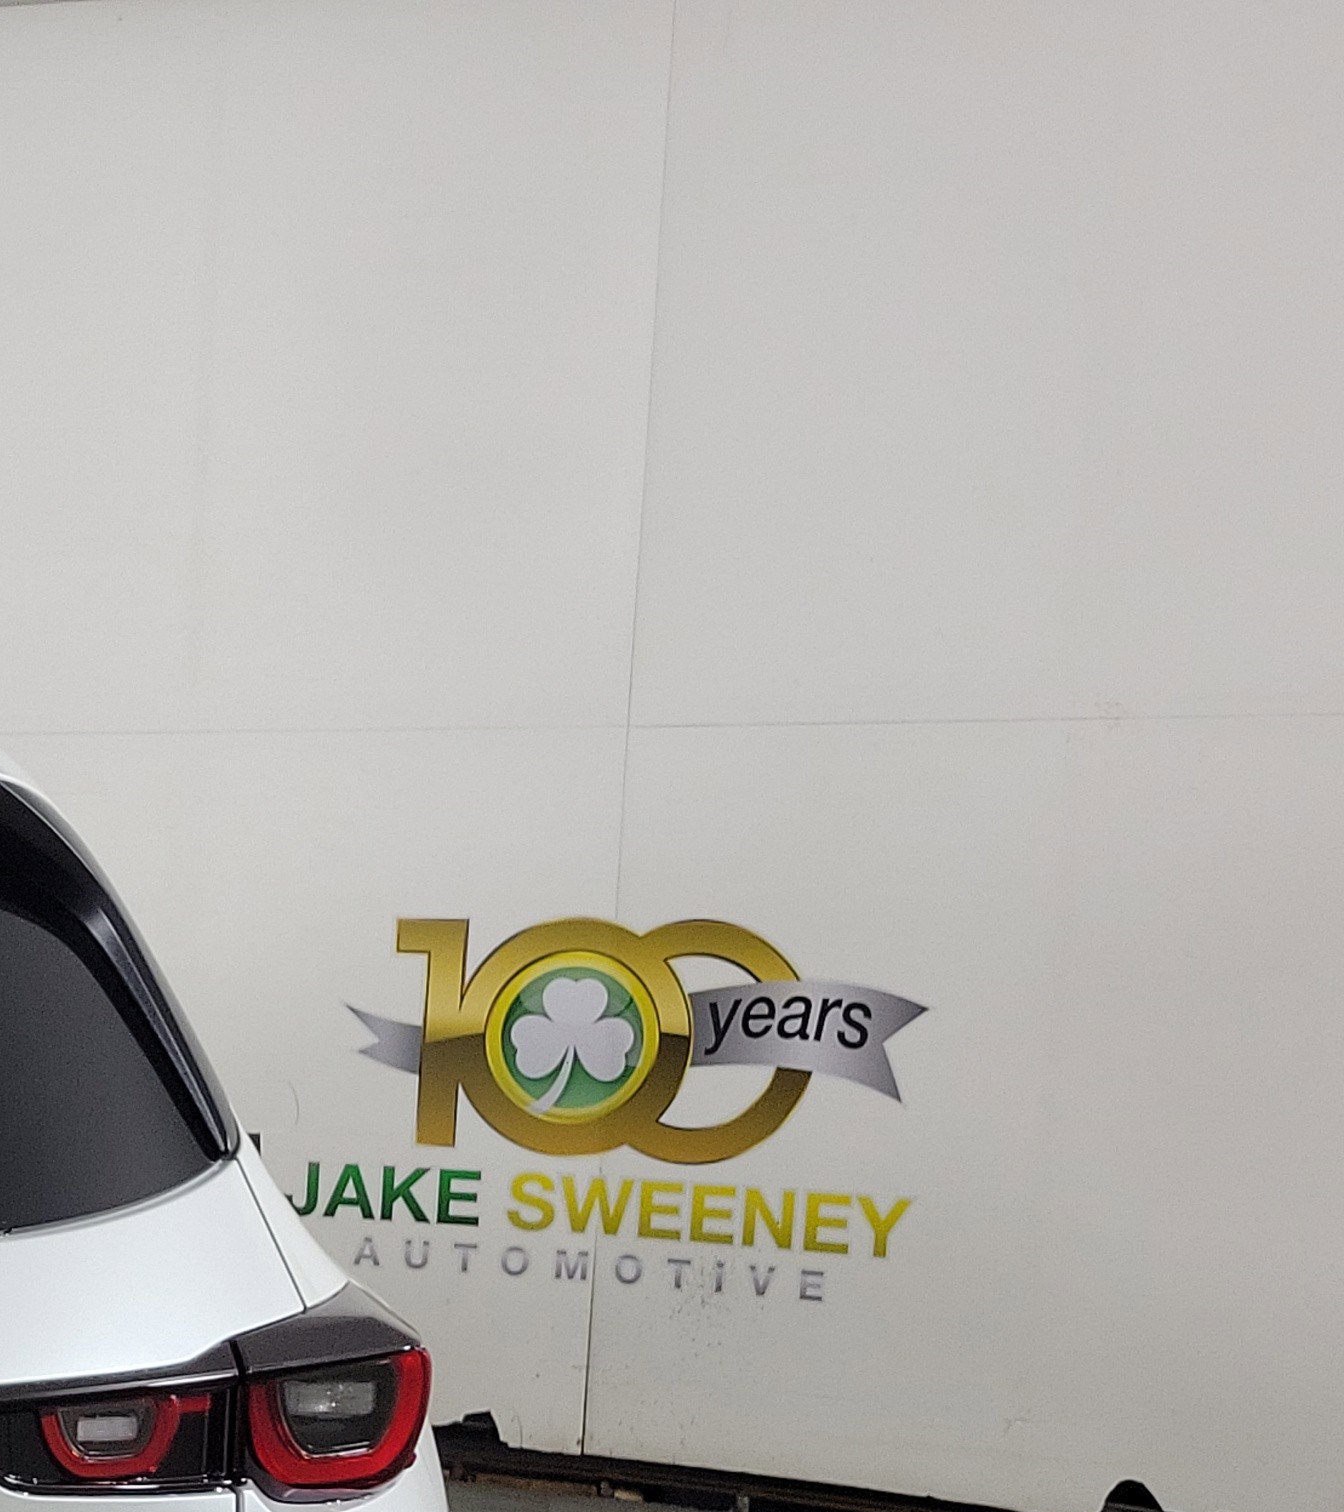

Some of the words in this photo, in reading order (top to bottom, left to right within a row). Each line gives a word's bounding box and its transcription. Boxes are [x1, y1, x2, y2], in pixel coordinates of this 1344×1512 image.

[395, 916, 812, 1165] 100
[703, 993, 873, 1056] years
[284, 1161, 482, 1227] JAKE
[507, 1172, 913, 1259] SWEENEY
[353, 1237, 825, 1303] AUTOMOTIVE
